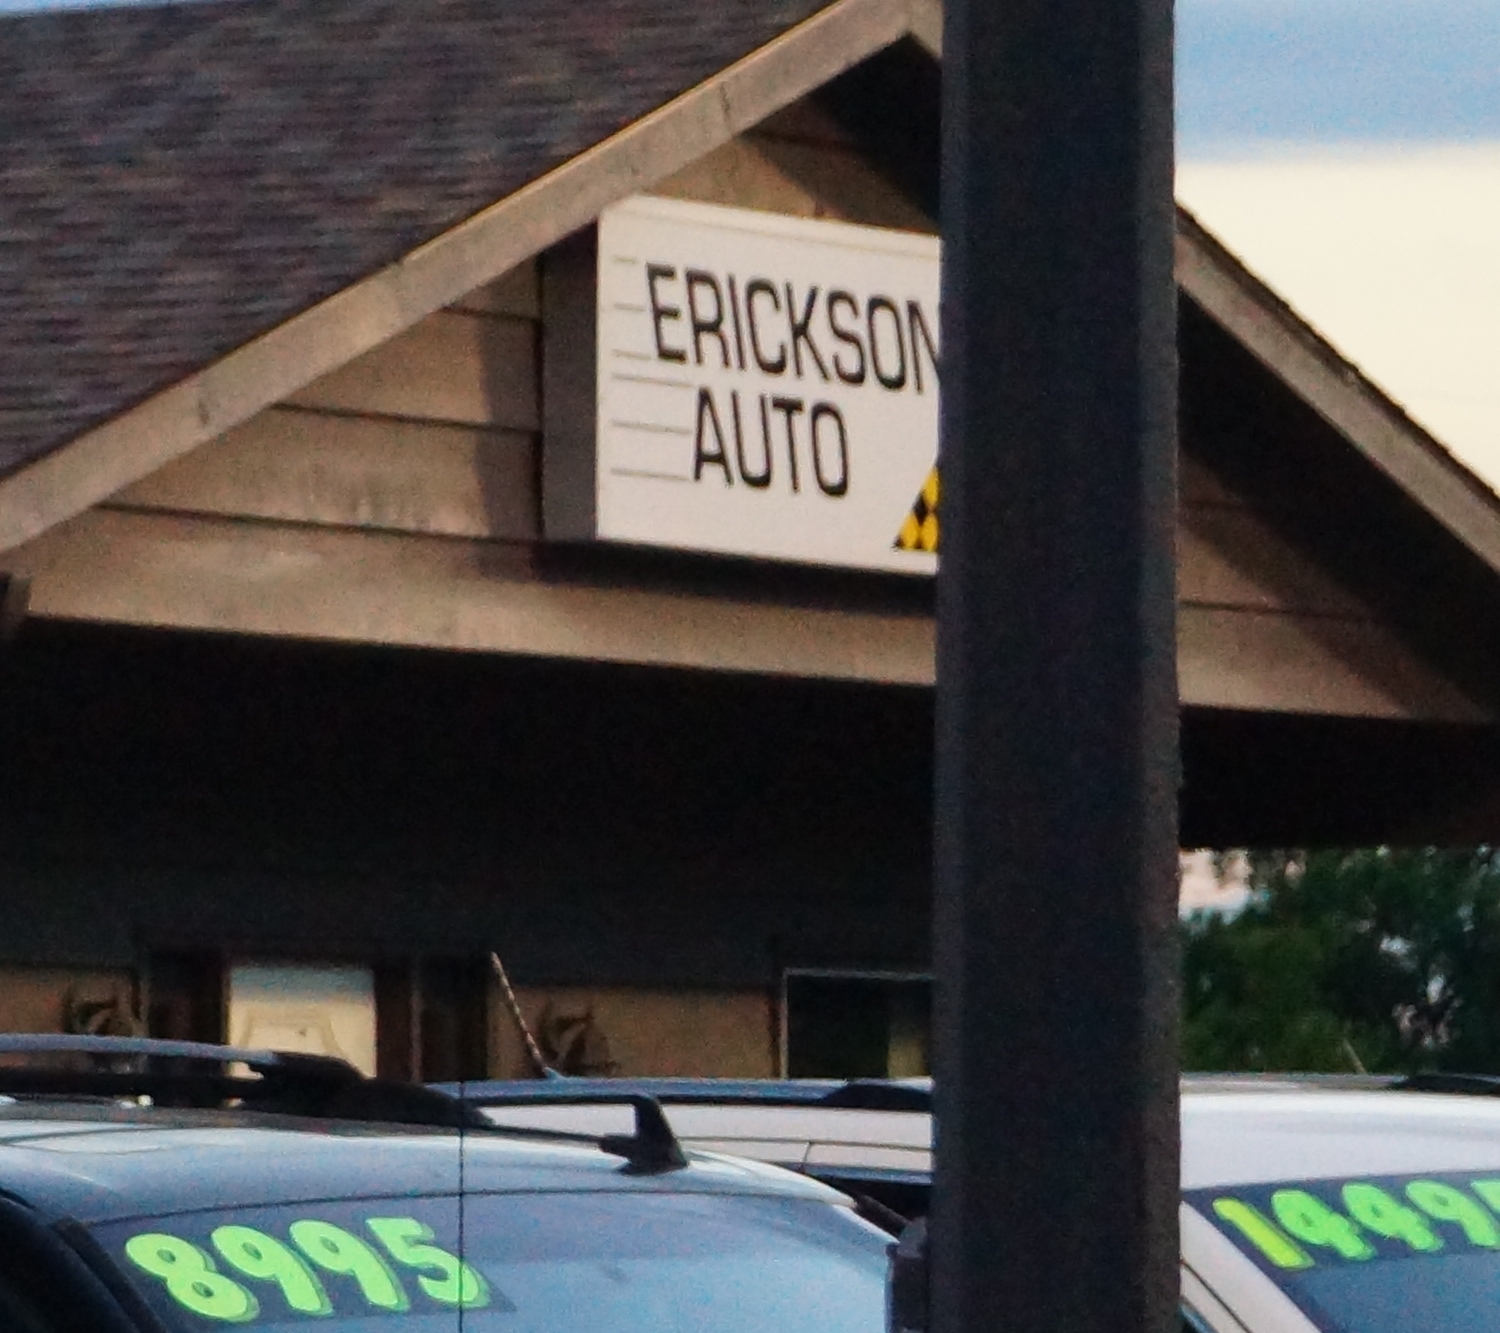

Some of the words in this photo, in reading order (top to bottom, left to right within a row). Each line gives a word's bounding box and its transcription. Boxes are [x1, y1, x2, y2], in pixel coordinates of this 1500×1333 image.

[645, 261, 940, 394] ERICKSON
[693, 386, 849, 497] AUTO
[125, 1217, 491, 1323] 8995
